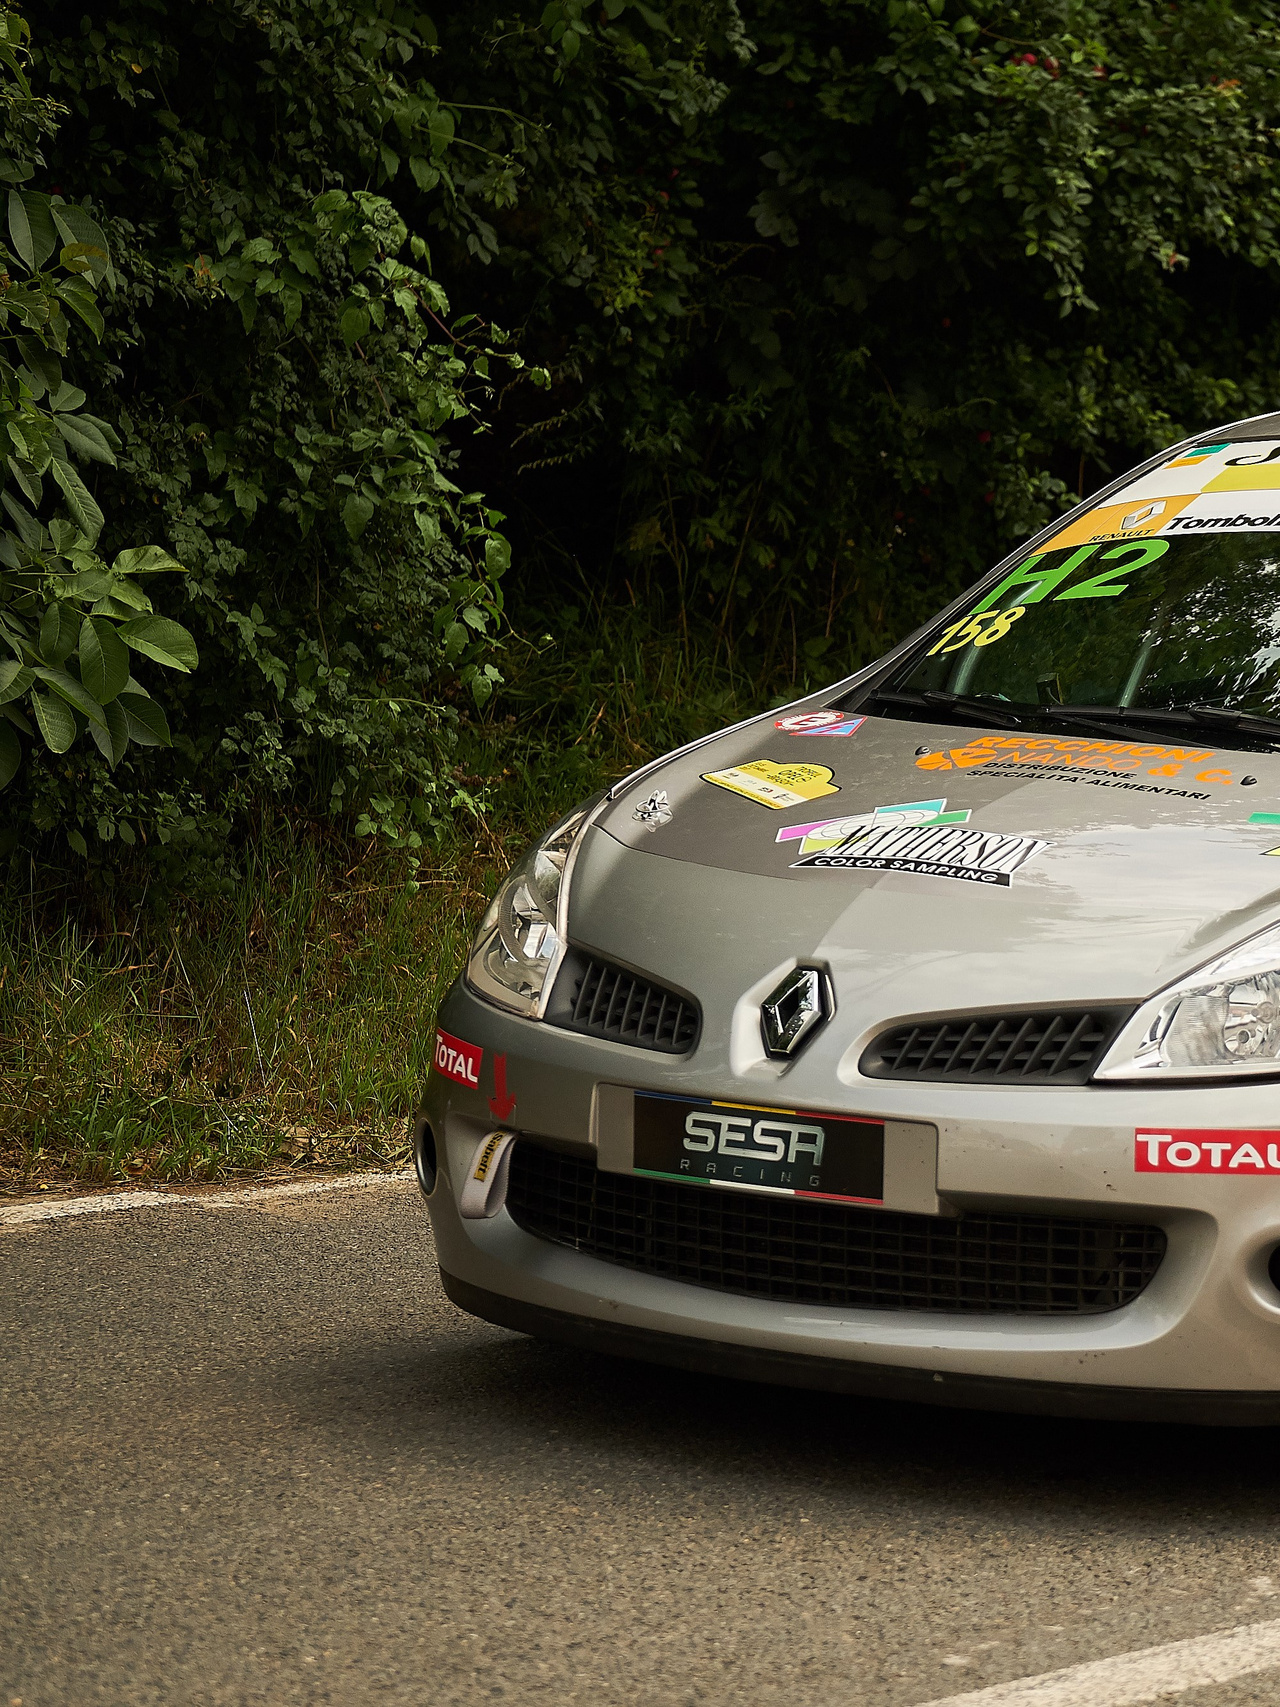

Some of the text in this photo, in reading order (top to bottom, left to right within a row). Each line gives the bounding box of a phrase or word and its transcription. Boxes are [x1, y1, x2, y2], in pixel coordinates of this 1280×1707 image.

[1088, 528, 1157, 543] RENAULT
[967, 539, 1170, 616] H2
[926, 606, 1026, 657] 158
[966, 736, 1217, 763] RECCHIONI
[966, 769, 1212, 801] SPECIALITA' ALIMENTARI
[981, 761, 1139, 780] DISTRIBUZIONE
[997, 751, 1235, 786] NANDO & C.
[822, 825, 1054, 873] MATHERSON
[814, 857, 999, 883] COLOR SAMPLING
[478, 1131, 504, 1175] Sabelt
[683, 1111, 826, 1167] SESA
[680, 1158, 821, 1187] RACING
